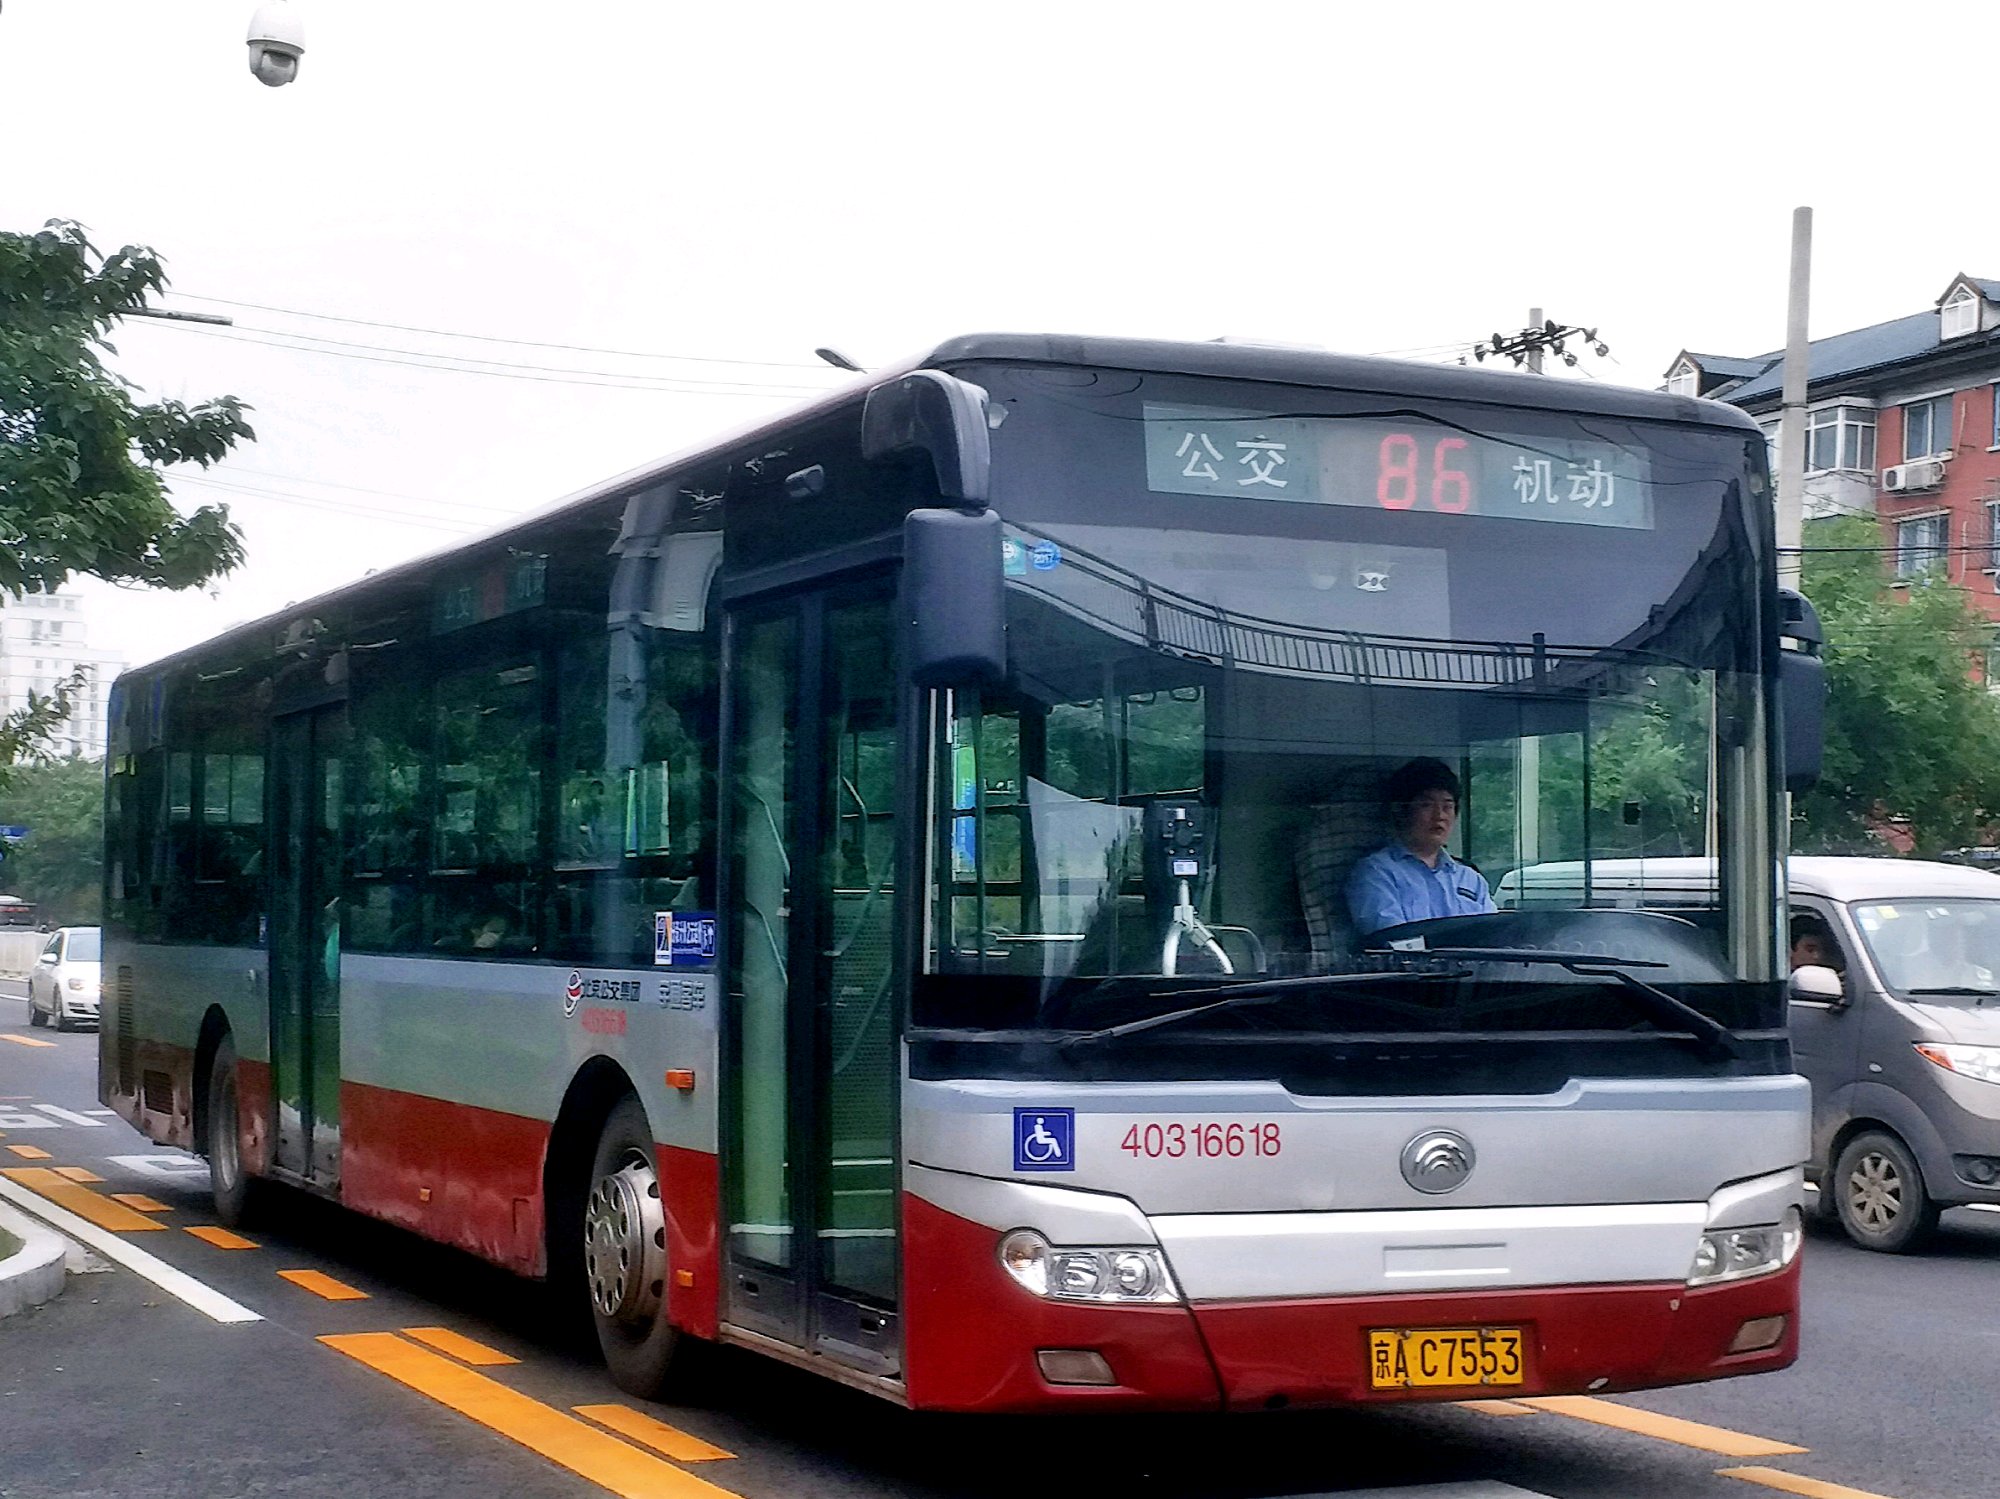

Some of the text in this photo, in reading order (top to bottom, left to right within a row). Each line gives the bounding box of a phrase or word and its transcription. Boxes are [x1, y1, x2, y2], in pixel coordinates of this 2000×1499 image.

[1174, 432, 1614, 513] 公交 86 机动
[1121, 1123, 1281, 1157] 40316618
